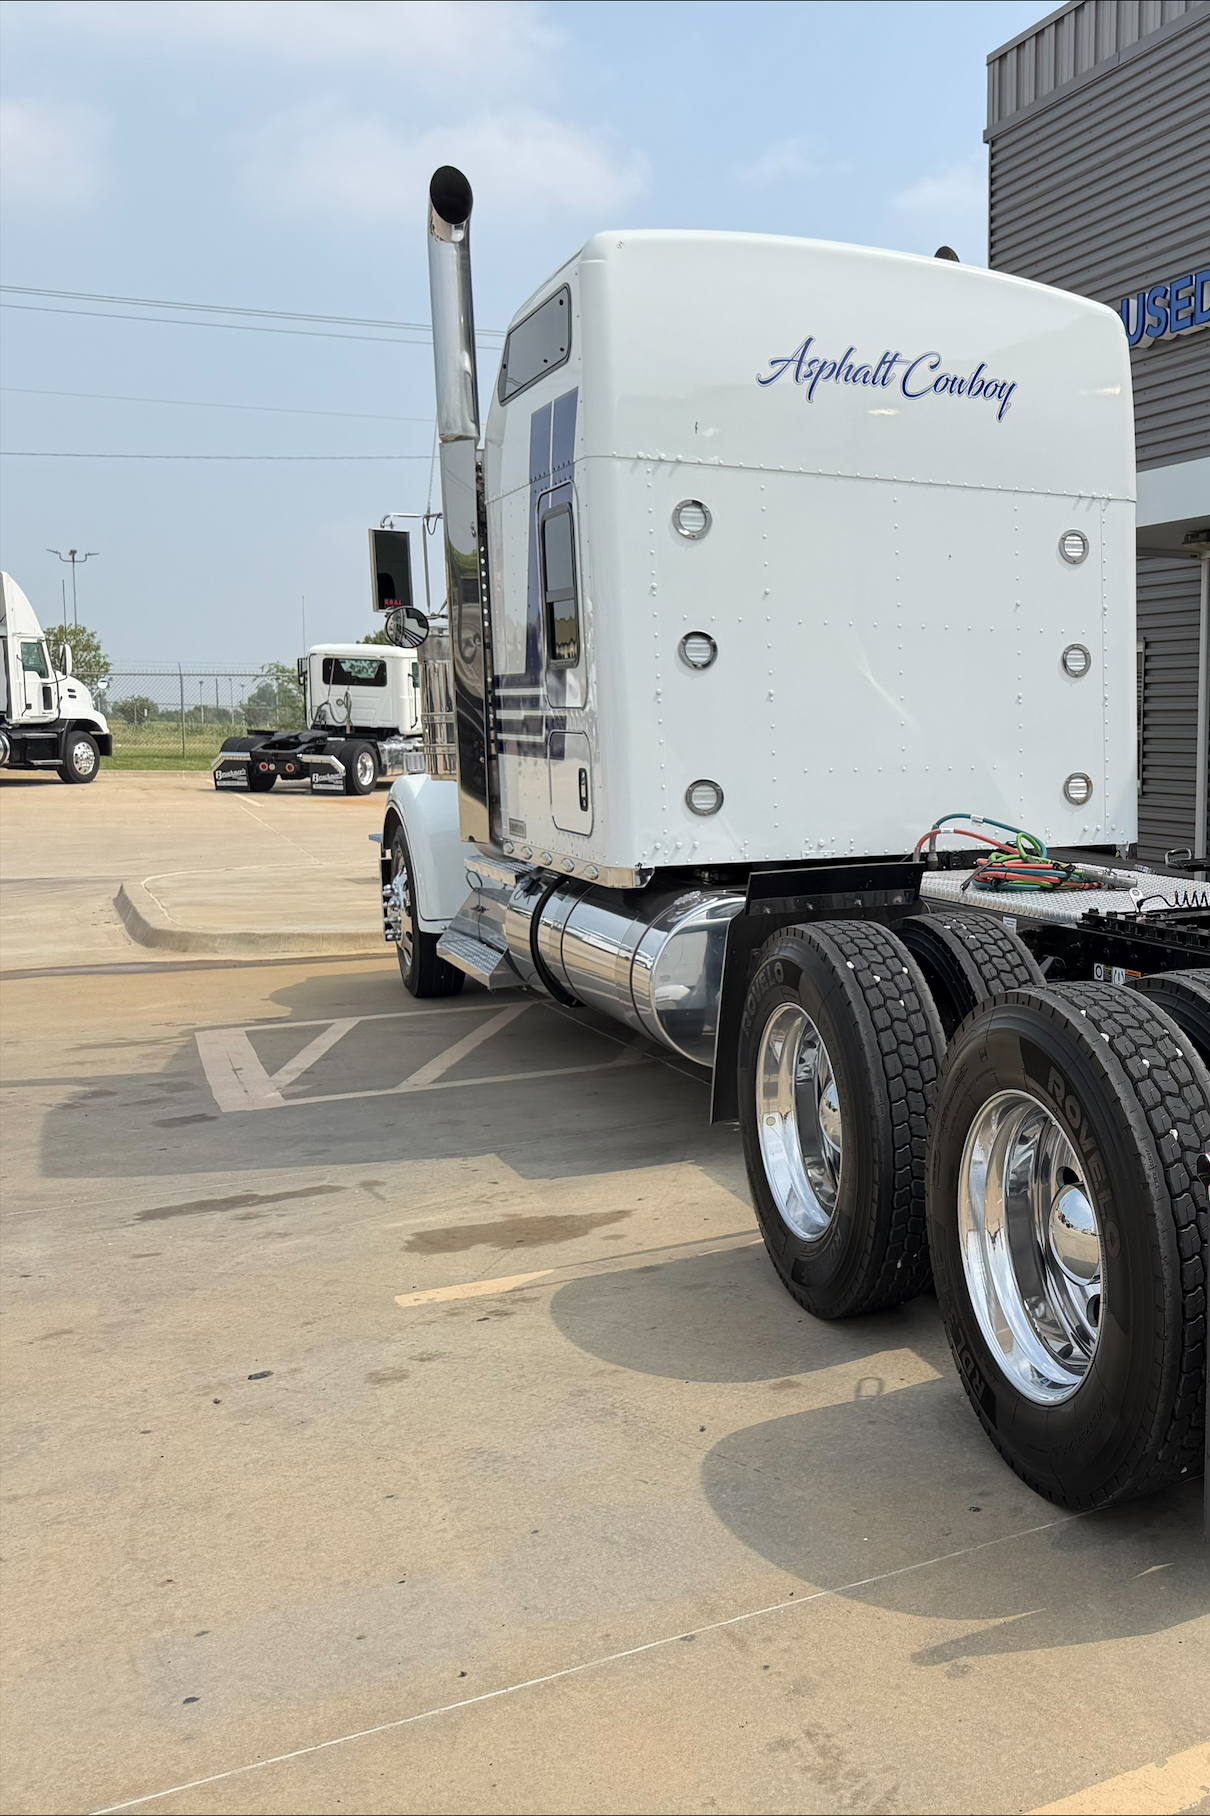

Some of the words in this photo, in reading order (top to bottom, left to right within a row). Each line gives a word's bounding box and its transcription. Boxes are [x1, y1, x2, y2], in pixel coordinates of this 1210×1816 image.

[756, 335, 903, 403] Asphalt
[900, 351, 1018, 423] Cowboy
[741, 961, 784, 1039] ROVELO
[1047, 1065, 1121, 1259] ROVELO
